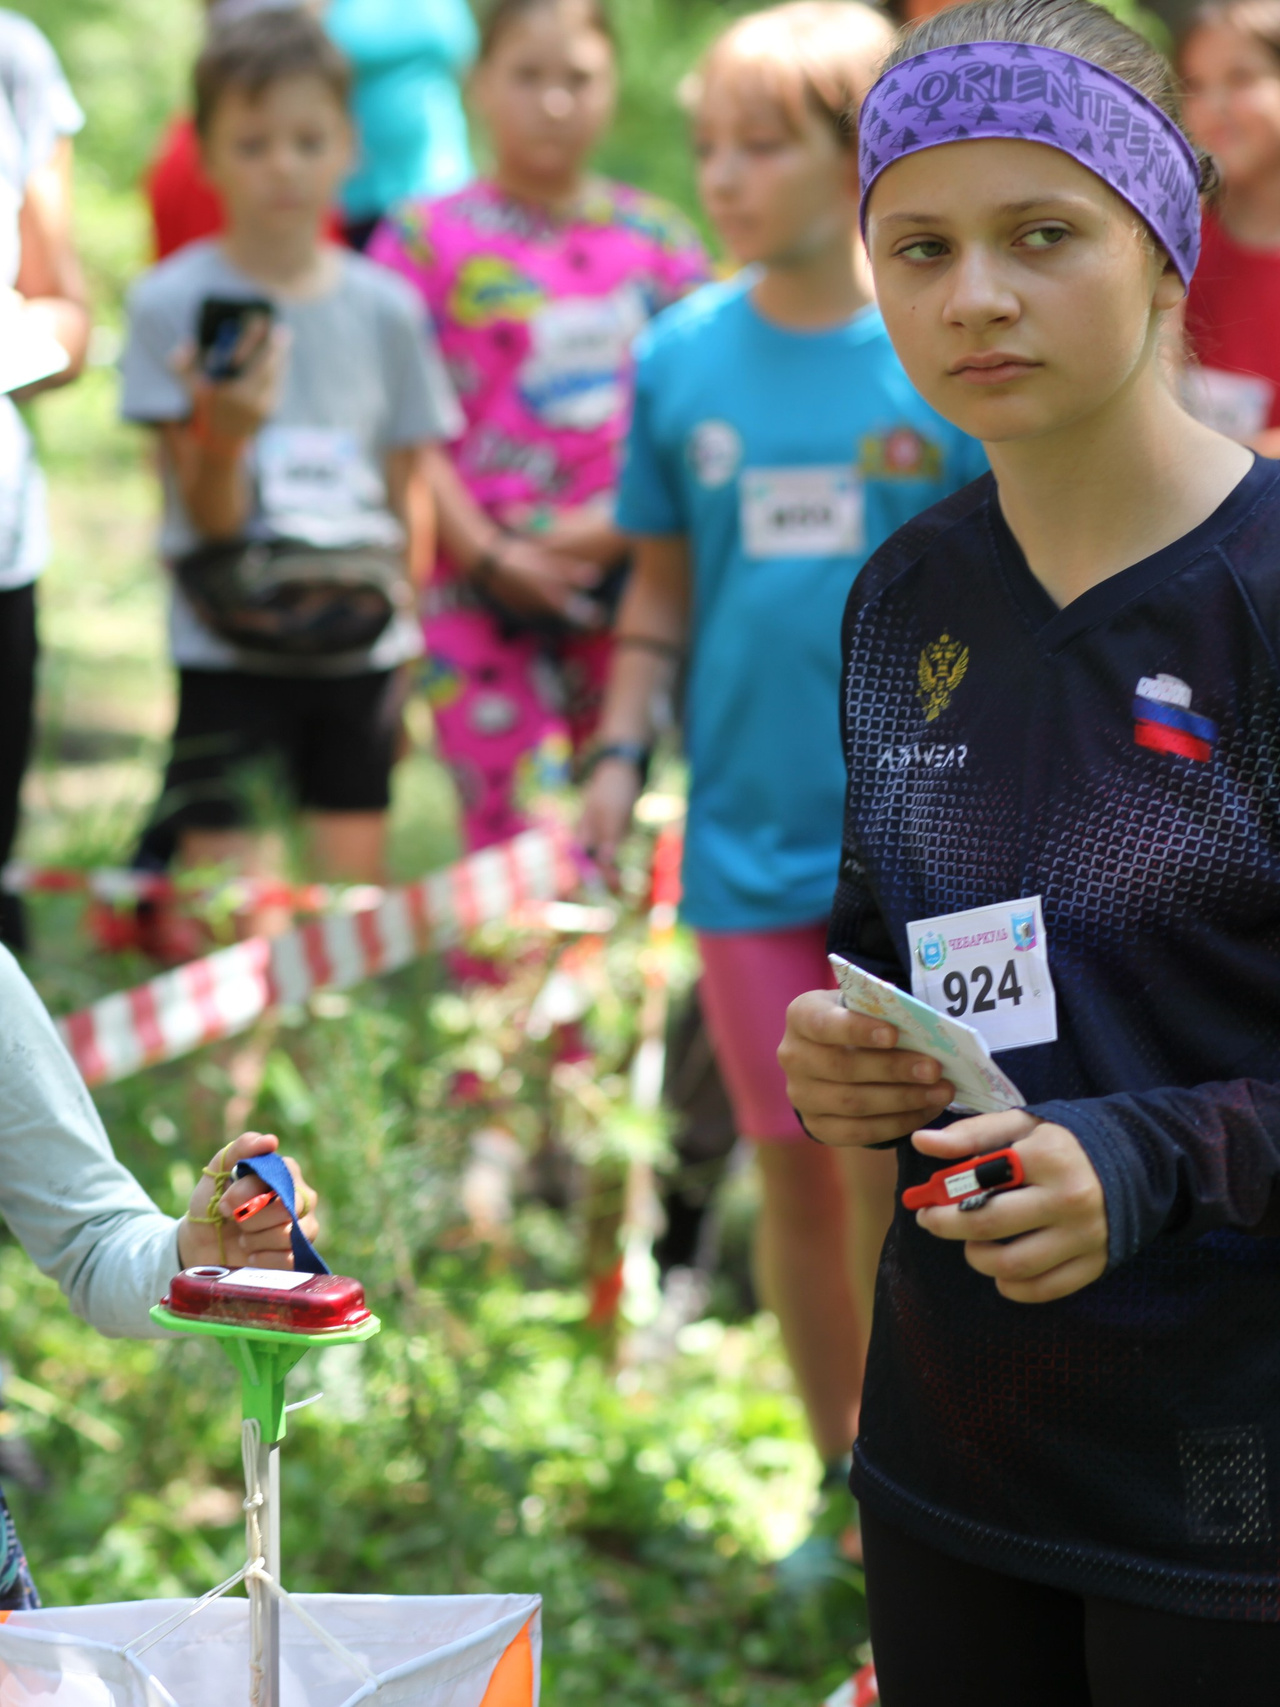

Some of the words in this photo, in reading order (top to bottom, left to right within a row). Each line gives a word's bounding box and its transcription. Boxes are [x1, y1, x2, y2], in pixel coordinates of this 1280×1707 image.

[913, 60, 1198, 220] ORIENTEERIN
[948, 928, 1009, 951] ЧЕБАРКУЛЬ
[942, 958, 1024, 1018] 924
